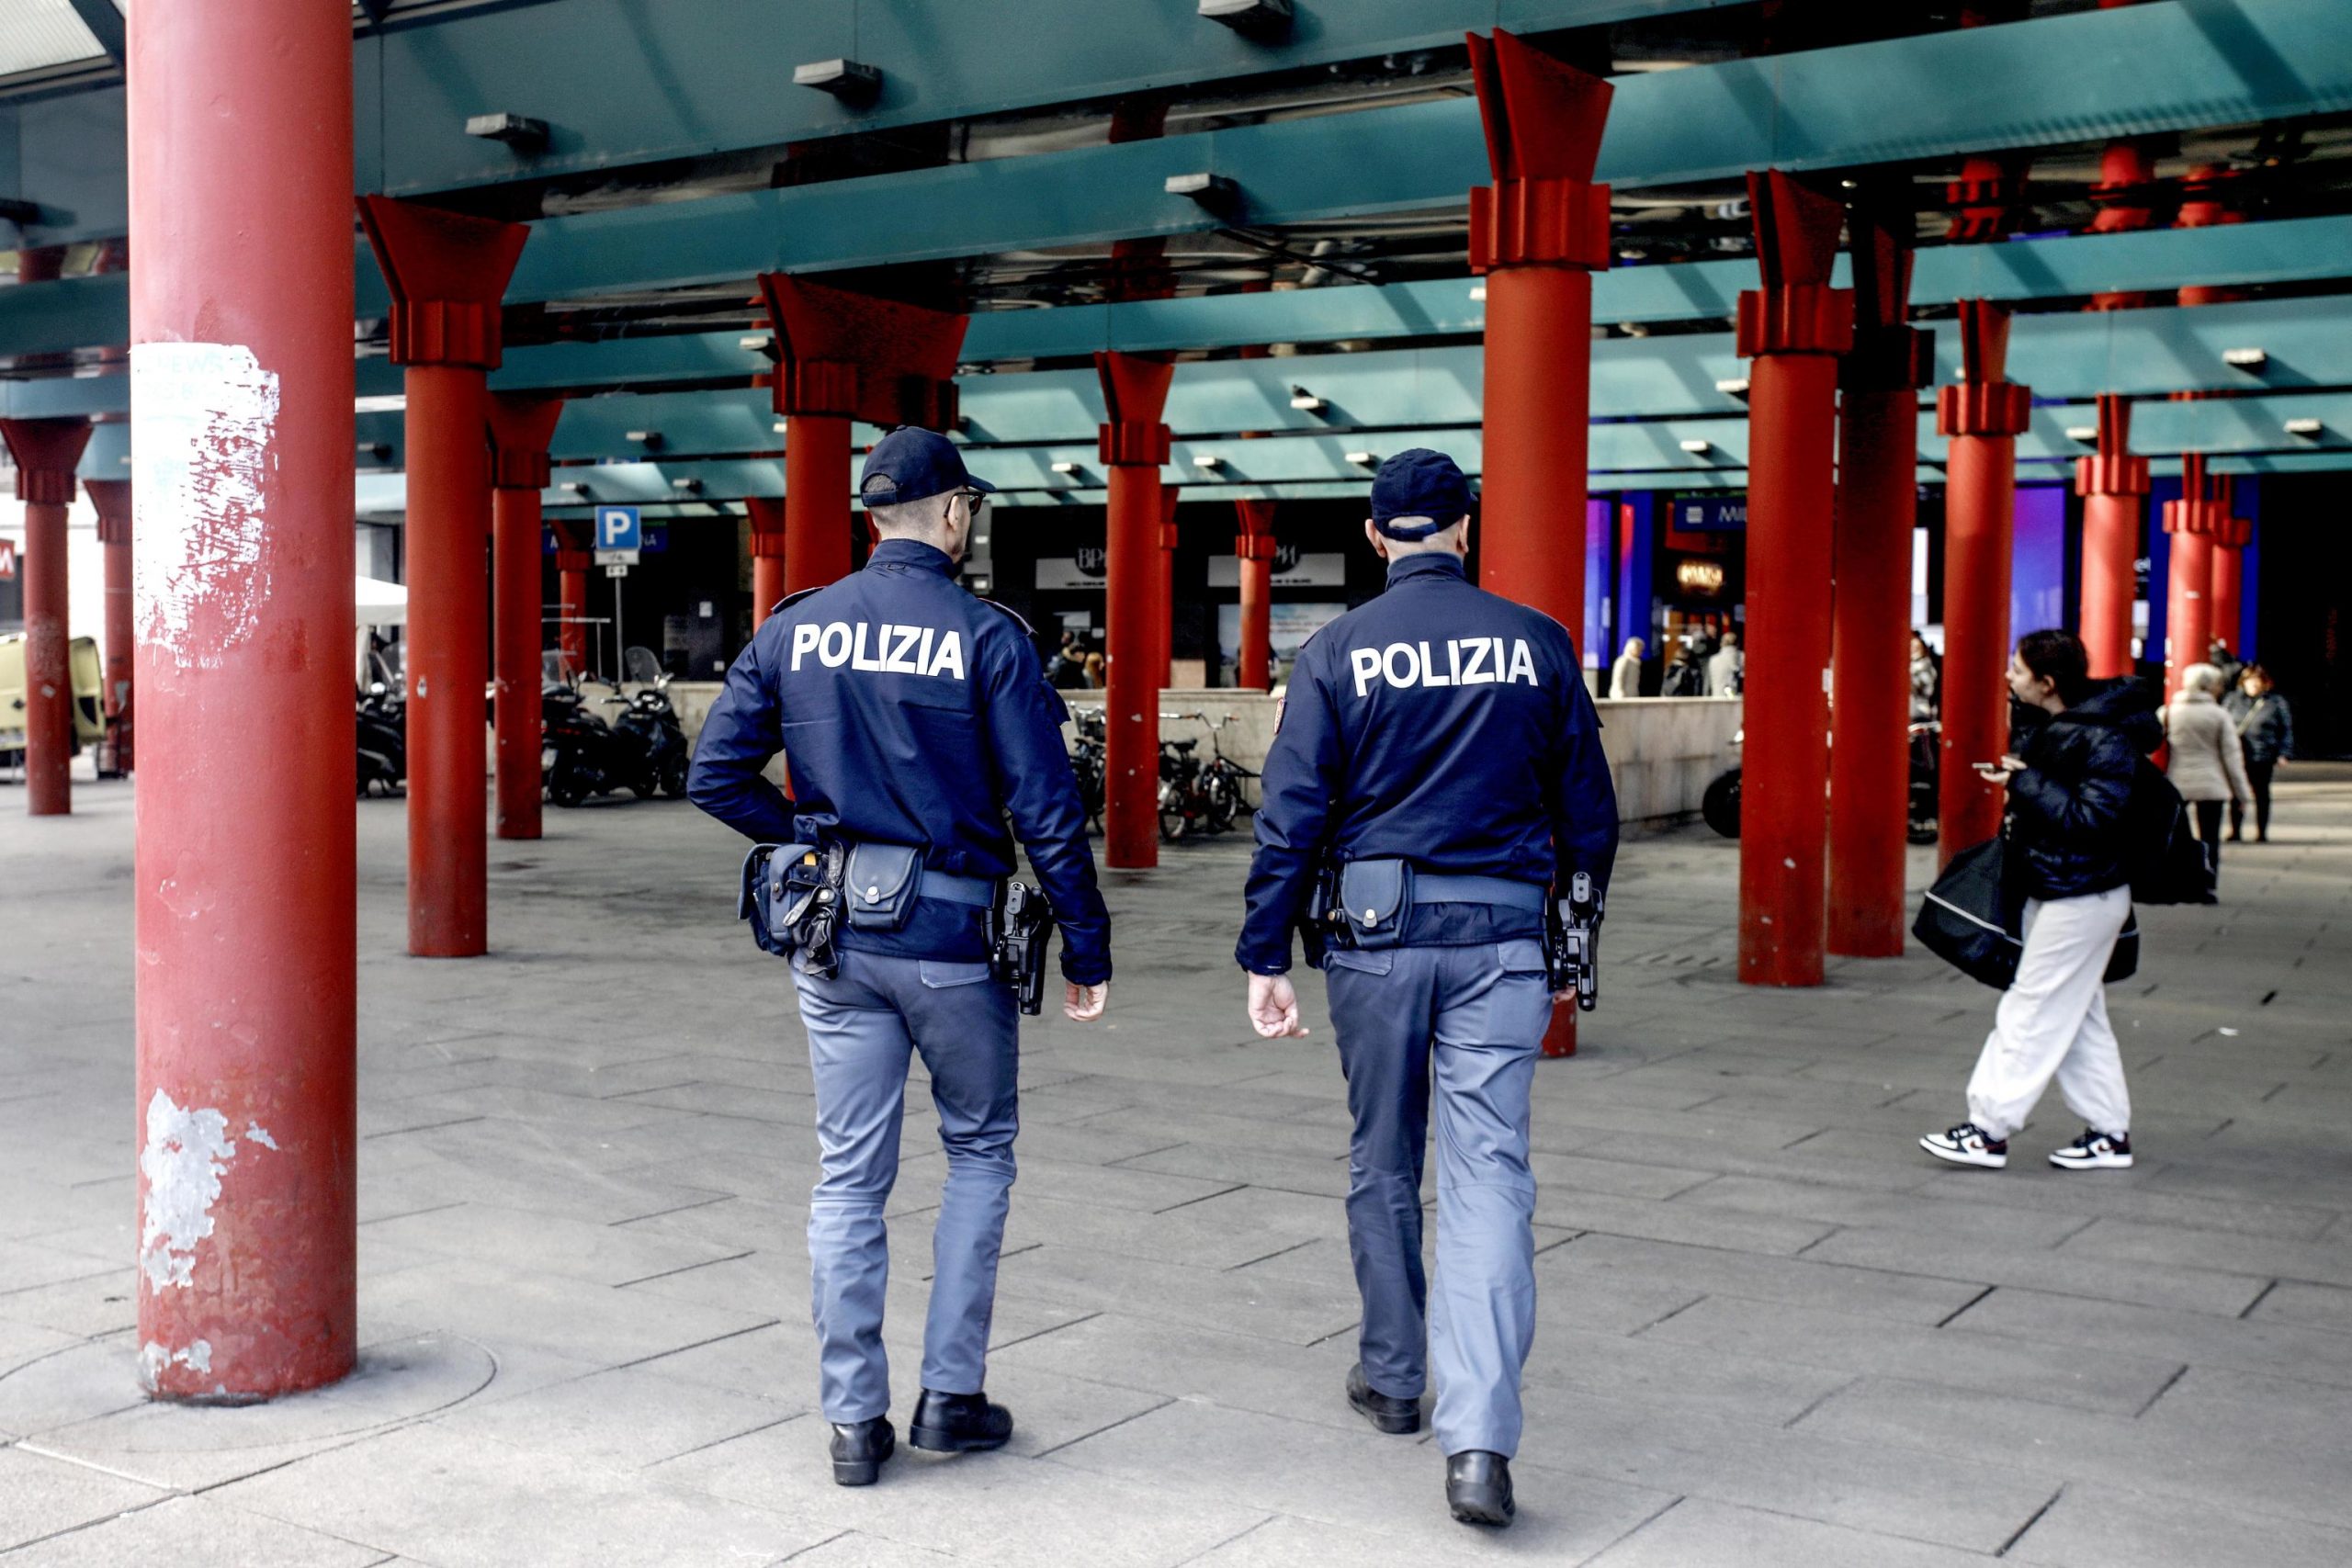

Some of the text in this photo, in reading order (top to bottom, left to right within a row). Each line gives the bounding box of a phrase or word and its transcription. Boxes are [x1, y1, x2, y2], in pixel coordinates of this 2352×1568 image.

[605, 511, 631, 545] P
[791, 621, 965, 681] POLIZIA
[1351, 637, 1539, 697] POLIZIA
